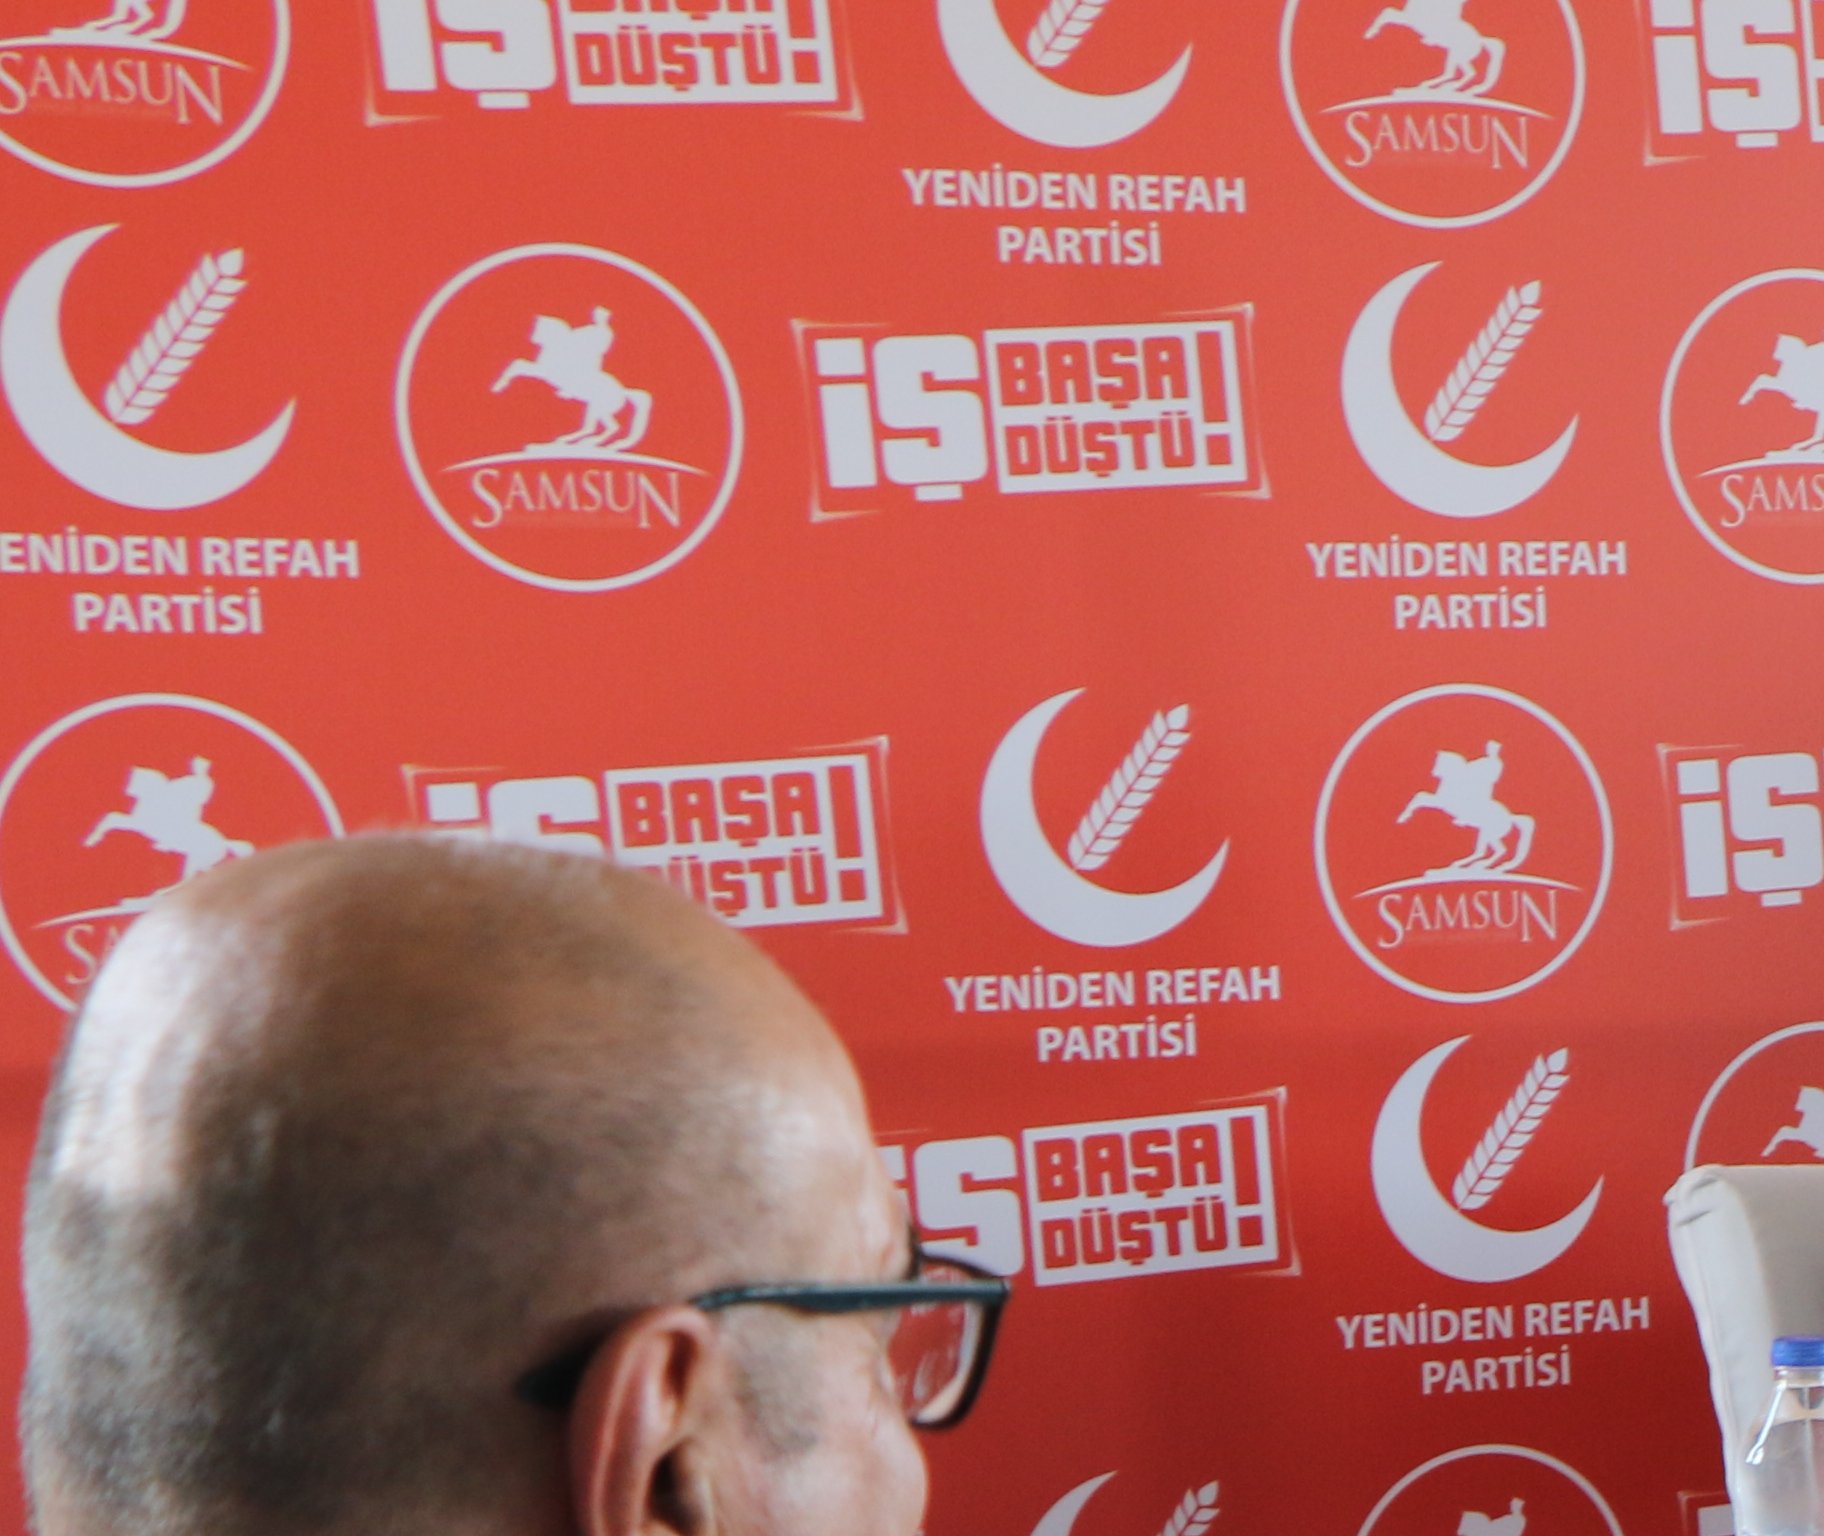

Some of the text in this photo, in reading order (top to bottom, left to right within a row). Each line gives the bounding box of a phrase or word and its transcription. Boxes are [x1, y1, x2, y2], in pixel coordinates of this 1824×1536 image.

[0, 51, 222, 124] SAMSUN
[1345, 110, 1529, 170] SAMSUN
[903, 163, 1246, 213] YENİDEN REFAH
[999, 220, 1161, 265] PARTİSİ
[996, 337, 1188, 409] BAŞA
[815, 334, 989, 502] İŞ
[471, 467, 682, 529] SAMSUN
[0, 526, 359, 577] ENİDEN REFAH
[1306, 535, 1626, 577] YENİDEN REFAH
[74, 586, 262, 634] PARTİSİ
[1395, 586, 1546, 629] PARTİSİ
[618, 772, 820, 847] BAŞA
[1678, 753, 1824, 906] İŞ
[1377, 890, 1558, 949] SAMSUN
[945, 966, 1280, 1012] YENİDEN REFAH
[1038, 1013, 1196, 1061] PARTİSİ
[1035, 1124, 1222, 1202] BAŞA
[1336, 1296, 1650, 1349] YENİDEN REFAH
[1420, 1345, 1570, 1396] PARTİSİ
